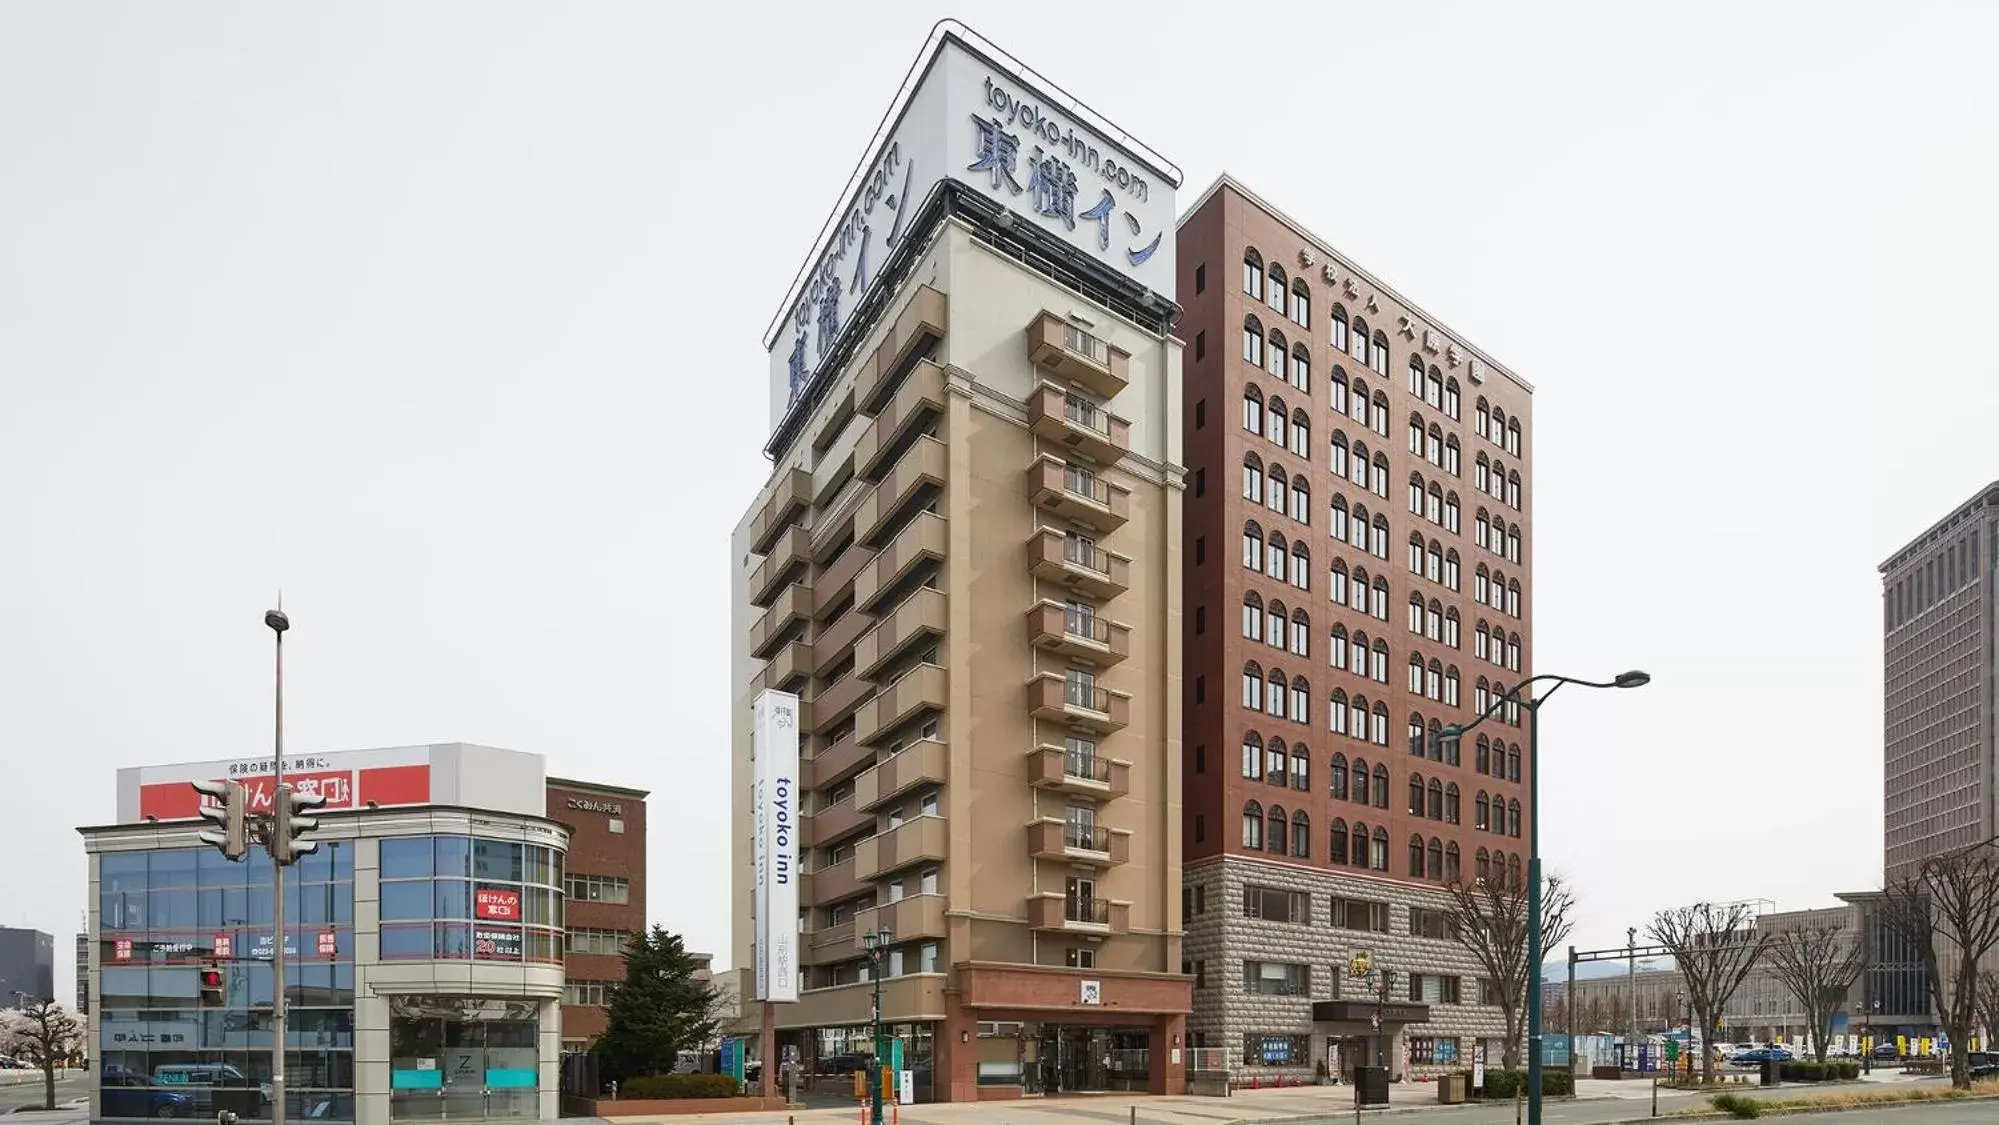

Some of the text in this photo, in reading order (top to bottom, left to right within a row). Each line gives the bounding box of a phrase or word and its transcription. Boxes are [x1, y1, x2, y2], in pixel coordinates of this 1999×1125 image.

[967, 113, 1162, 266] 東横イン
[984, 76, 1148, 202] toyoko-inn.com
[788, 158, 913, 406] 東横イン
[795, 141, 900, 333] toyoko-inn.com
[773, 778, 791, 884] toyoko inn
[476, 940, 520, 954] 20社以上
[478, 893, 518, 906] ほけんの
[488, 904, 509, 915] 窓口
